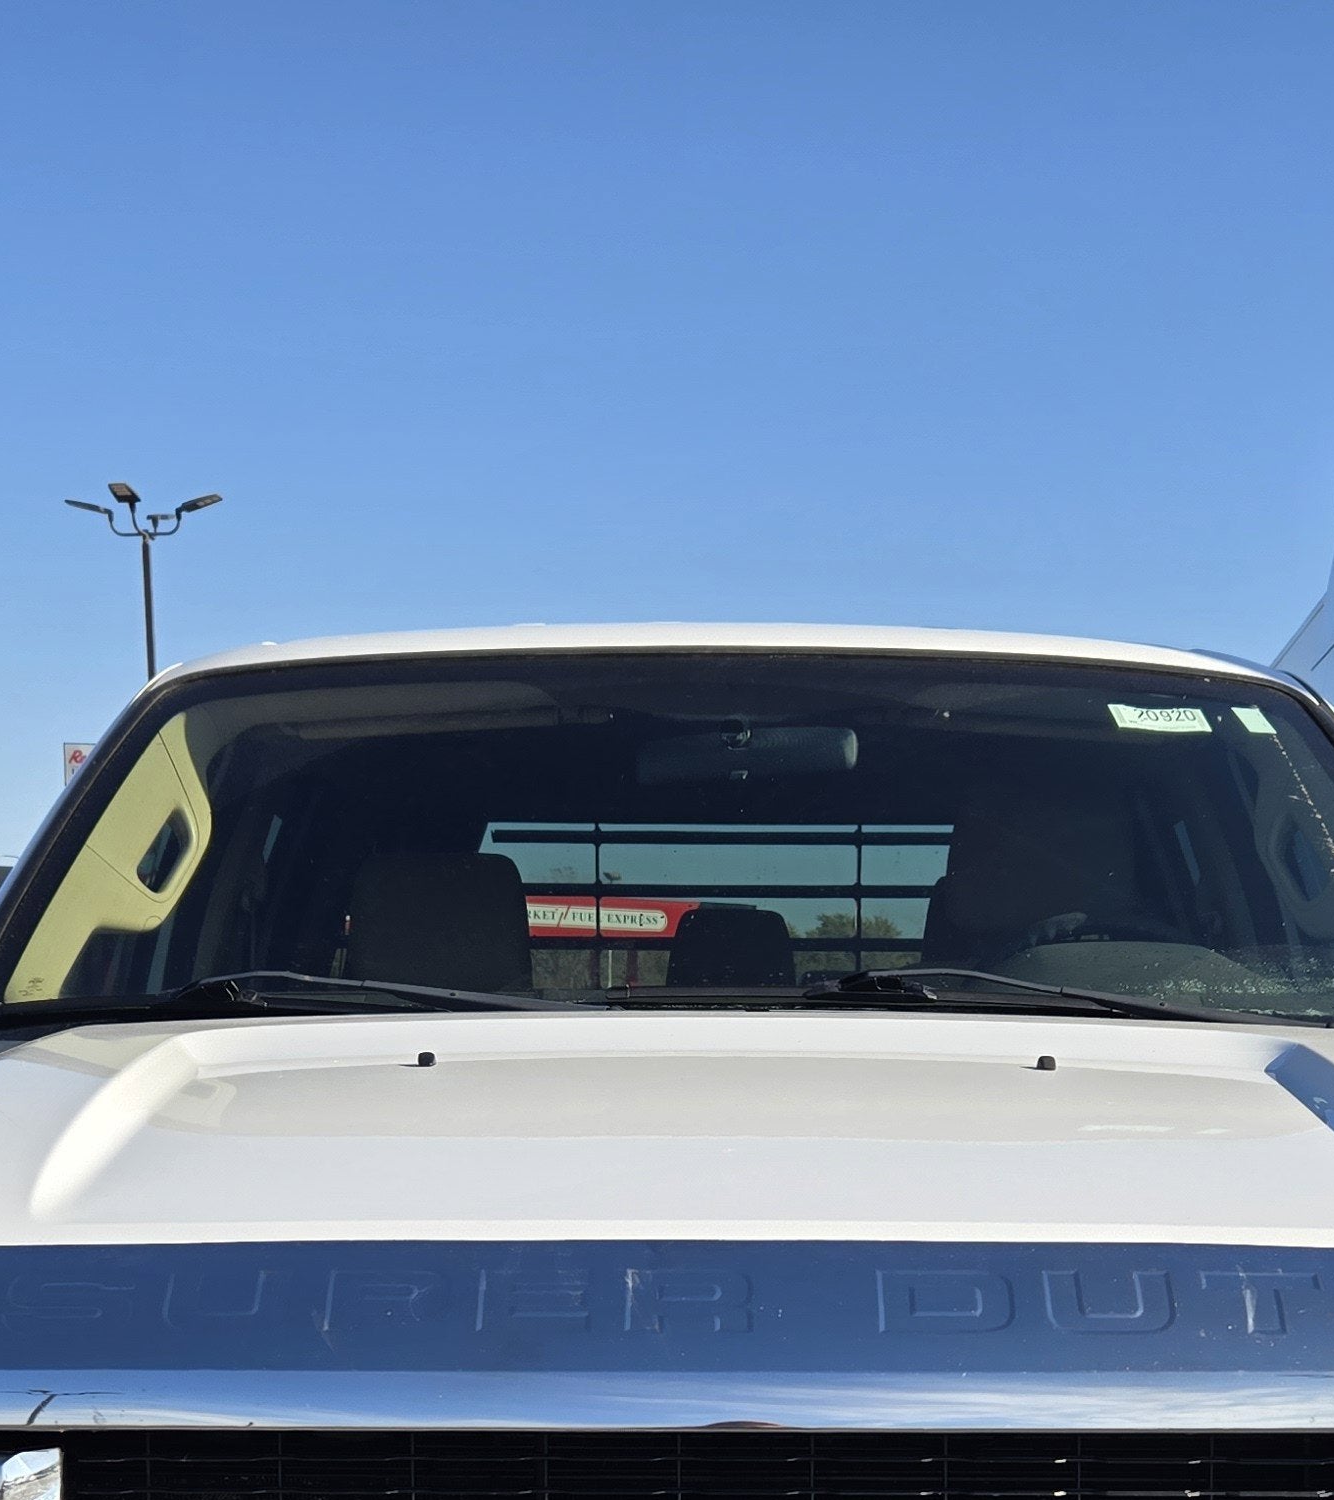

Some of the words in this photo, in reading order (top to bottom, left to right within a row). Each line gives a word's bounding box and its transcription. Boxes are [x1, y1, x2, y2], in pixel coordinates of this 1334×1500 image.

[1134, 709, 1196, 722] 20920
[607, 913, 658, 925] EXPRESS
[4, 1267, 755, 1333] SUPER
